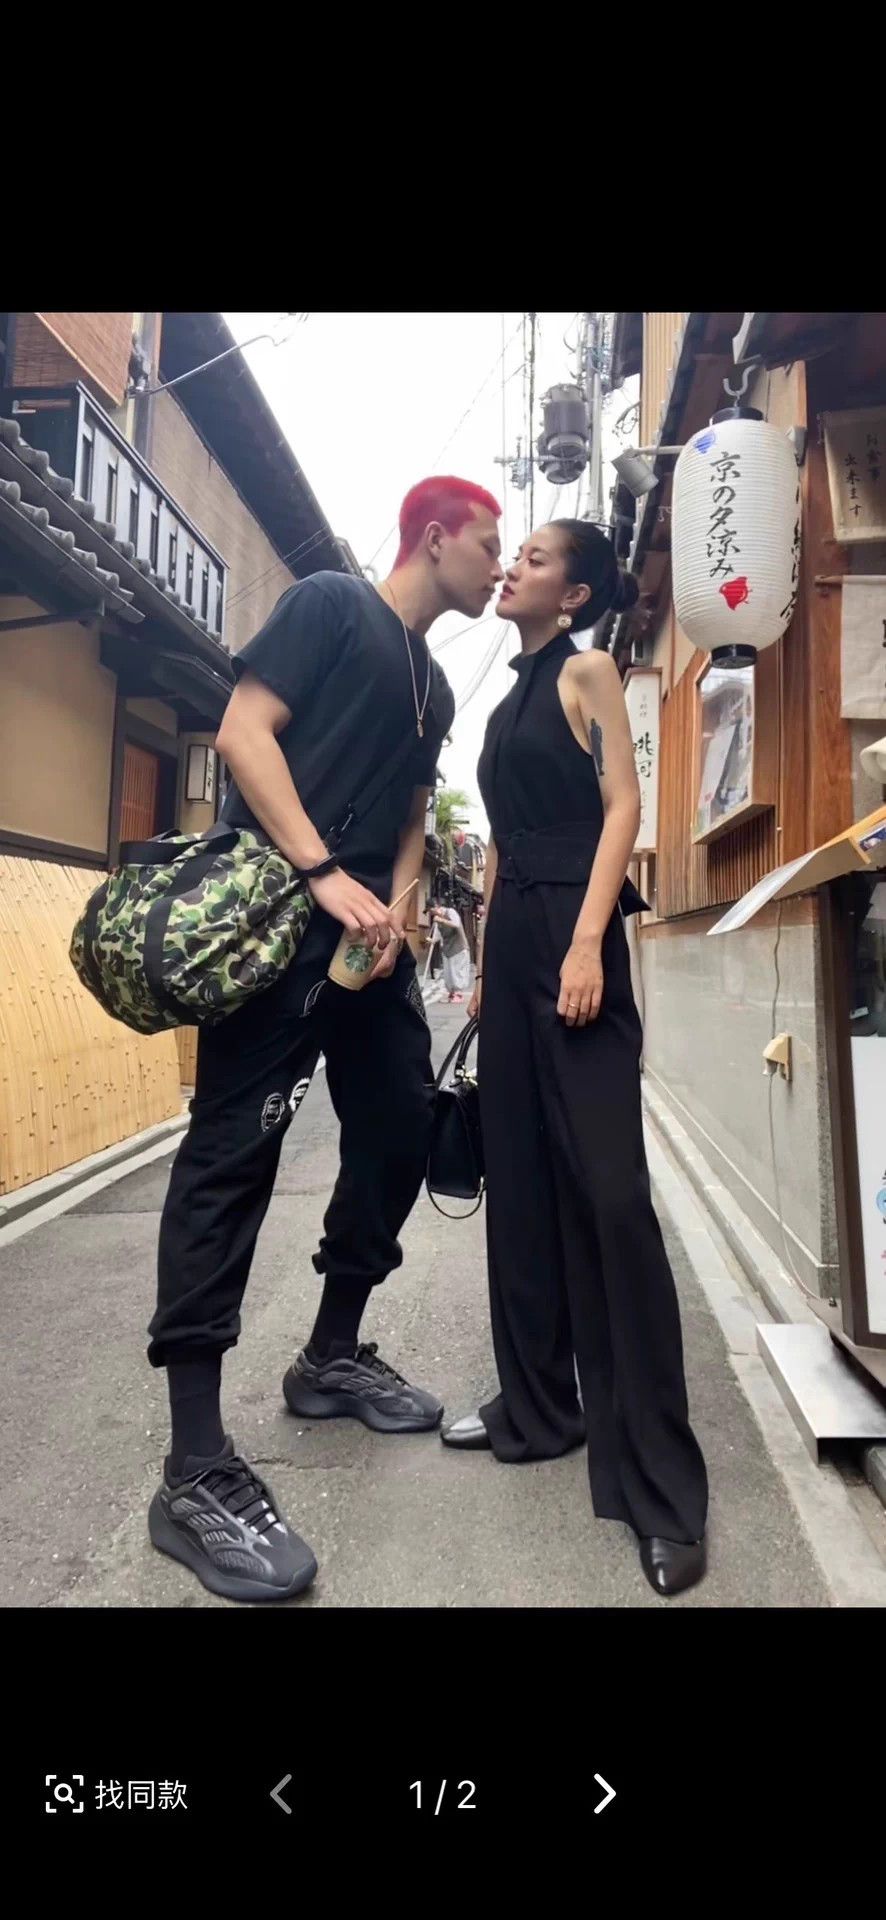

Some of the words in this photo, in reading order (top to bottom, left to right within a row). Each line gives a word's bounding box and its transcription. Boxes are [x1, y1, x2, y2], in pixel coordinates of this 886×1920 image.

[706, 451, 741, 579] 京の夕涼み
